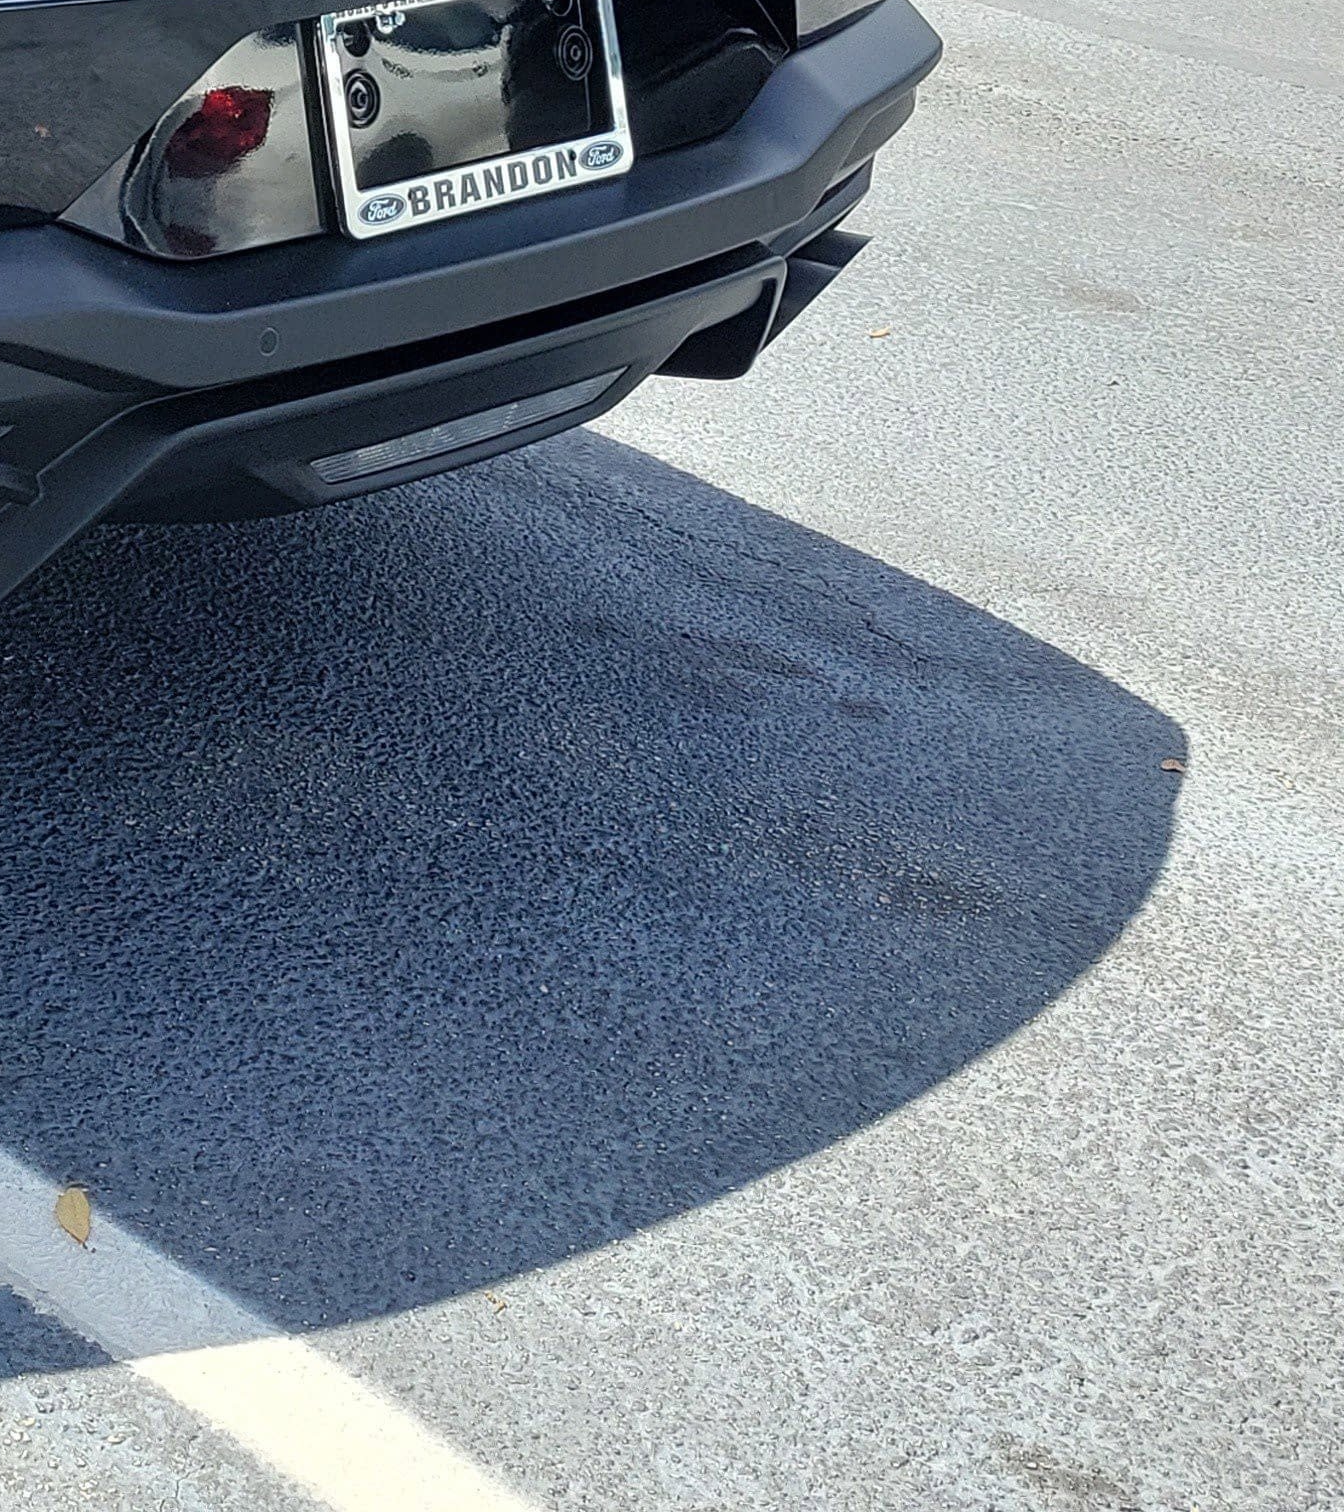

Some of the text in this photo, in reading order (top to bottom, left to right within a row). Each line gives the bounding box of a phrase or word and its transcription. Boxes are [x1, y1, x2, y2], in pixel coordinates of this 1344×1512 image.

[367, 144, 614, 221] Ford BRANDON Ford
